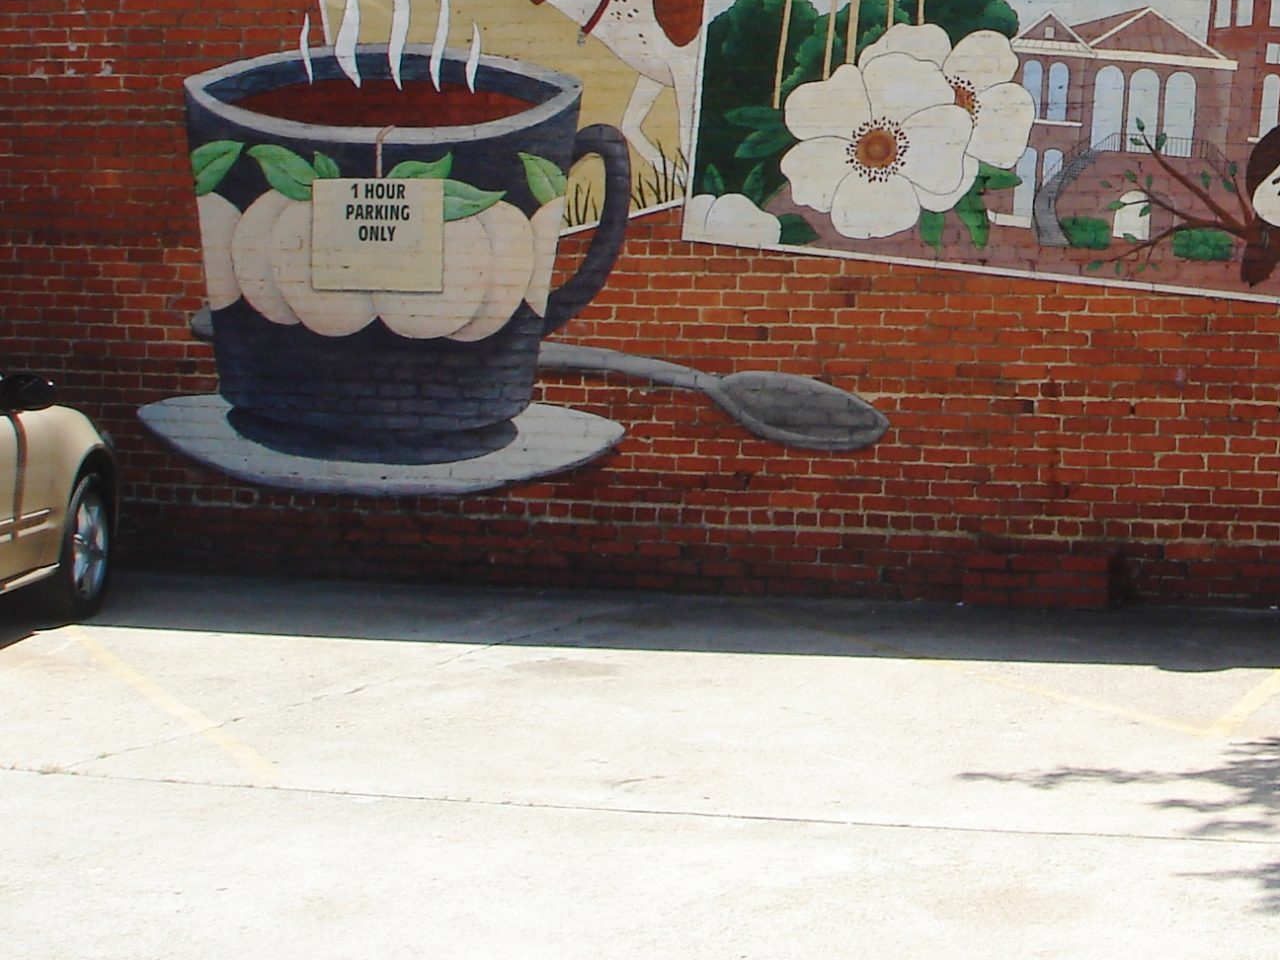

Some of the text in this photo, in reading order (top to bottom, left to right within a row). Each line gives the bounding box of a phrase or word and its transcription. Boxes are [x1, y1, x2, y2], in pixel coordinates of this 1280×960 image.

[350, 183, 406, 200] 1 HOUR
[345, 204, 411, 221] PARKING
[358, 225, 396, 242] ONLY
